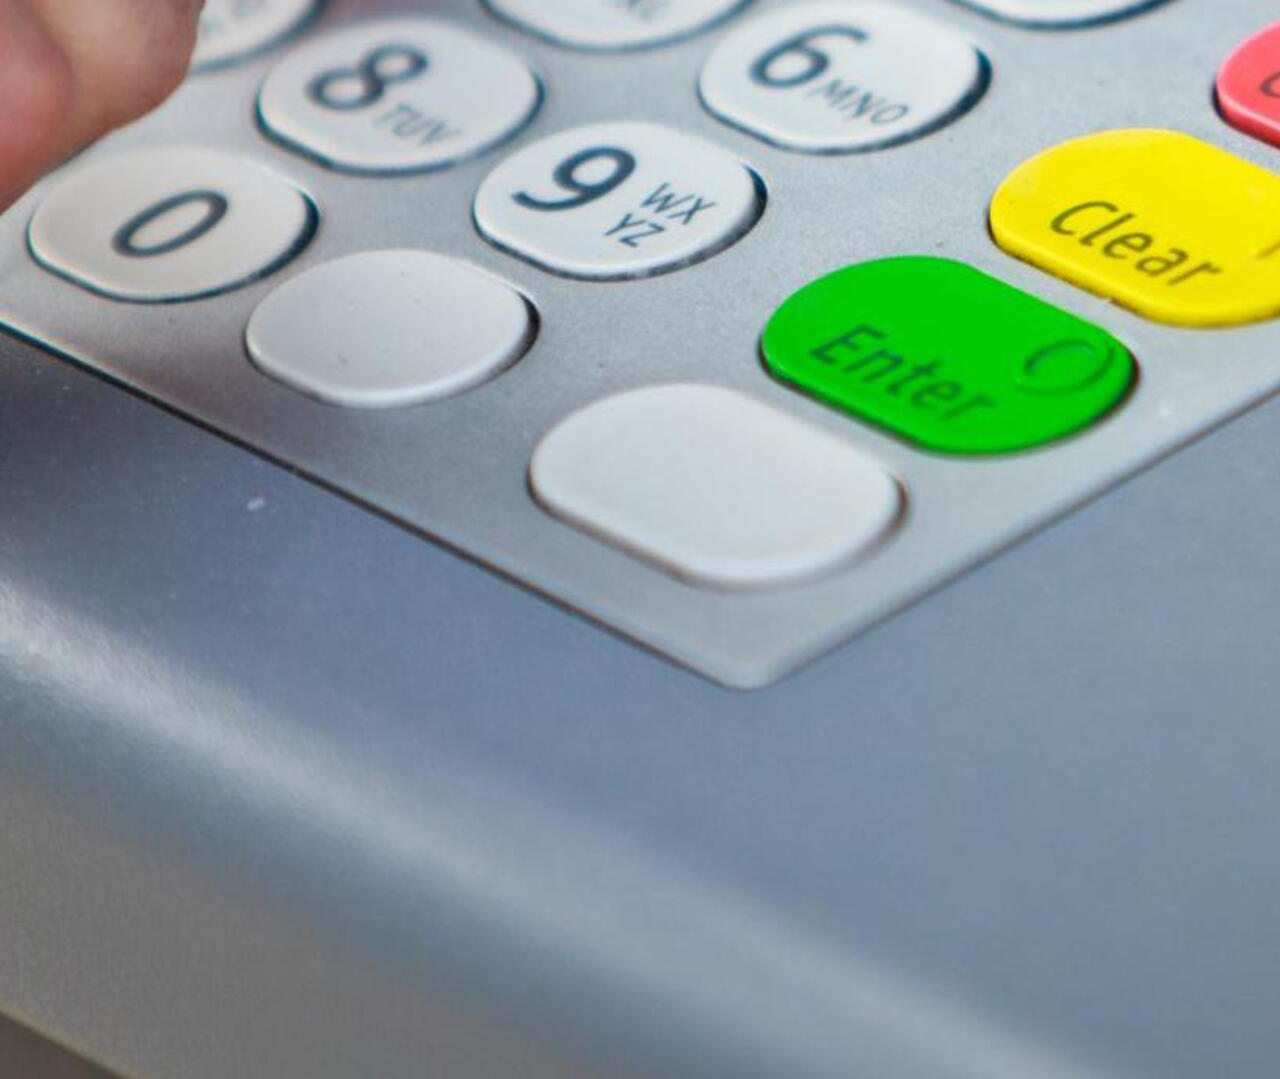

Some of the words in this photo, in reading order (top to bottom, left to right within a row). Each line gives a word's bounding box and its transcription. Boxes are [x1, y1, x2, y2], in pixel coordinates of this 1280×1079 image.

[306, 43, 429, 110] 8
[374, 103, 463, 145] TUV
[749, 24, 868, 89] 6
[808, 78, 910, 124] MNO
[511, 145, 636, 212] 9
[639, 182, 716, 225] WX
[111, 188, 228, 258] 0
[603, 213, 665, 248] YZ
[1050, 200, 1223, 286] Clear
[809, 324, 999, 418] Enter
